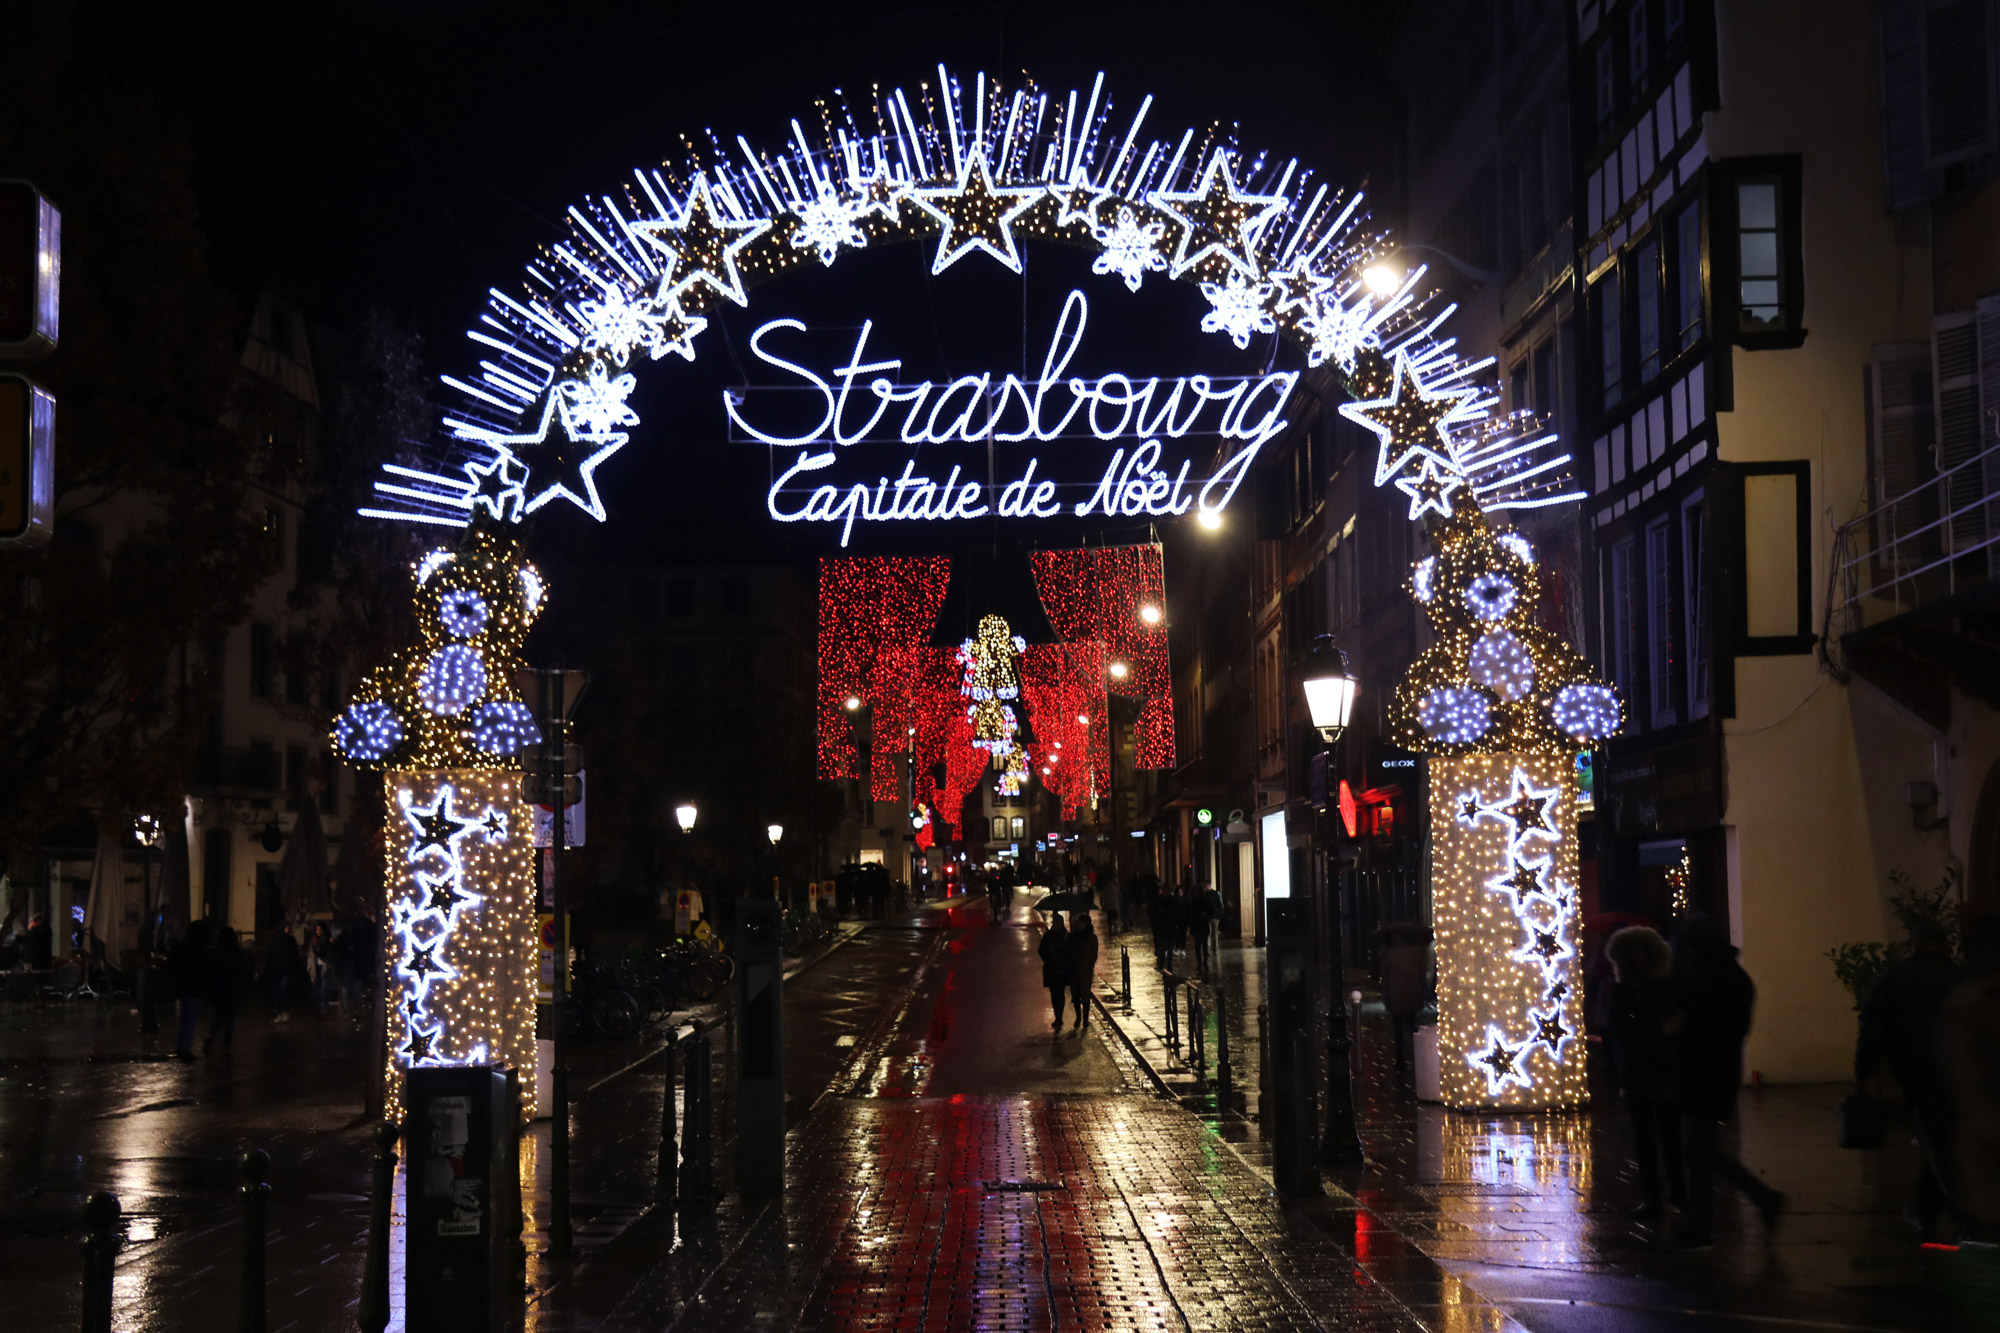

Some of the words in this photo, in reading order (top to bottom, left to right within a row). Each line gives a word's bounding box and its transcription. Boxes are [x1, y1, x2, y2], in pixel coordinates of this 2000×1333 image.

[722, 288, 1301, 515] Strasbourg
[767, 450, 990, 549] Capitale
[999, 458, 1062, 518] de
[1074, 439, 1192, 517] Noël
[1381, 759, 1415, 768] GEOX
